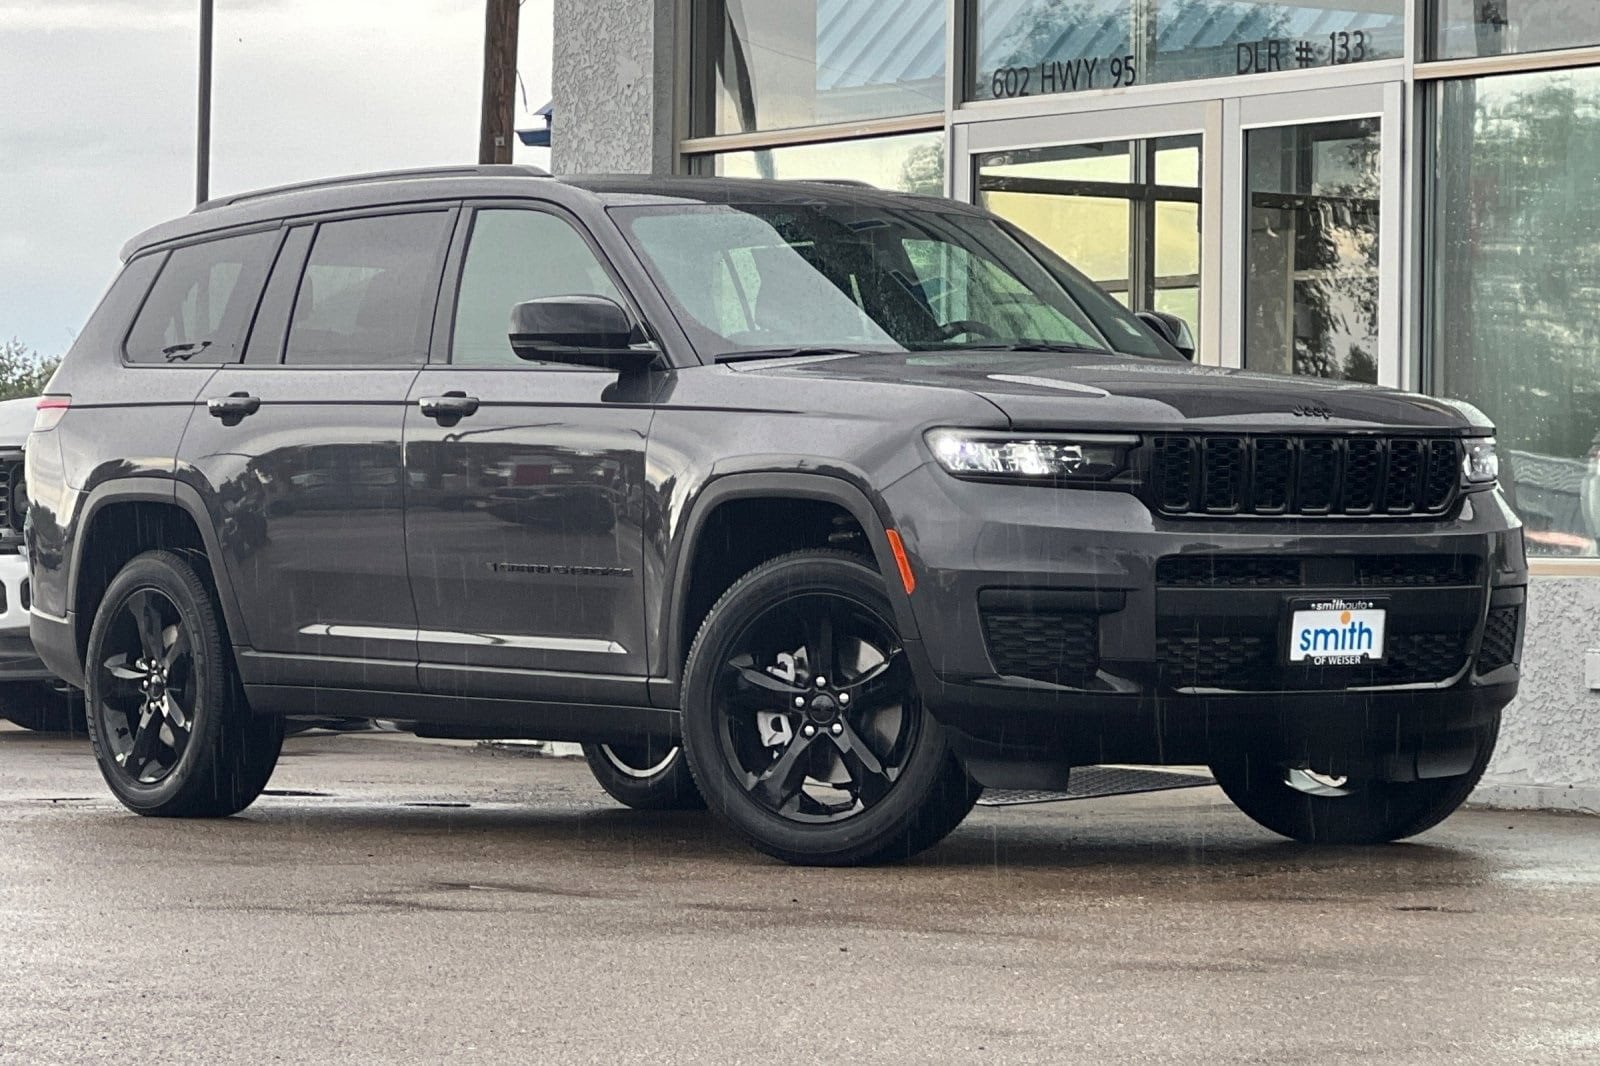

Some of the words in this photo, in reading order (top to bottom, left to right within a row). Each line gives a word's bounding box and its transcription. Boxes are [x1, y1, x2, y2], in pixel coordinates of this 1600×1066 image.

[1237, 40, 1281, 74] DLR
[1295, 41, 1313, 68] #
[1329, 30, 1365, 65] 133
[992, 66, 1030, 98] 602
[1041, 57, 1098, 93] HWY
[1110, 55, 1136, 88] 95
[1300, 611, 1373, 652] smith
[1313, 656, 1326, 666] OF
[1328, 655, 1361, 665] WEISER
